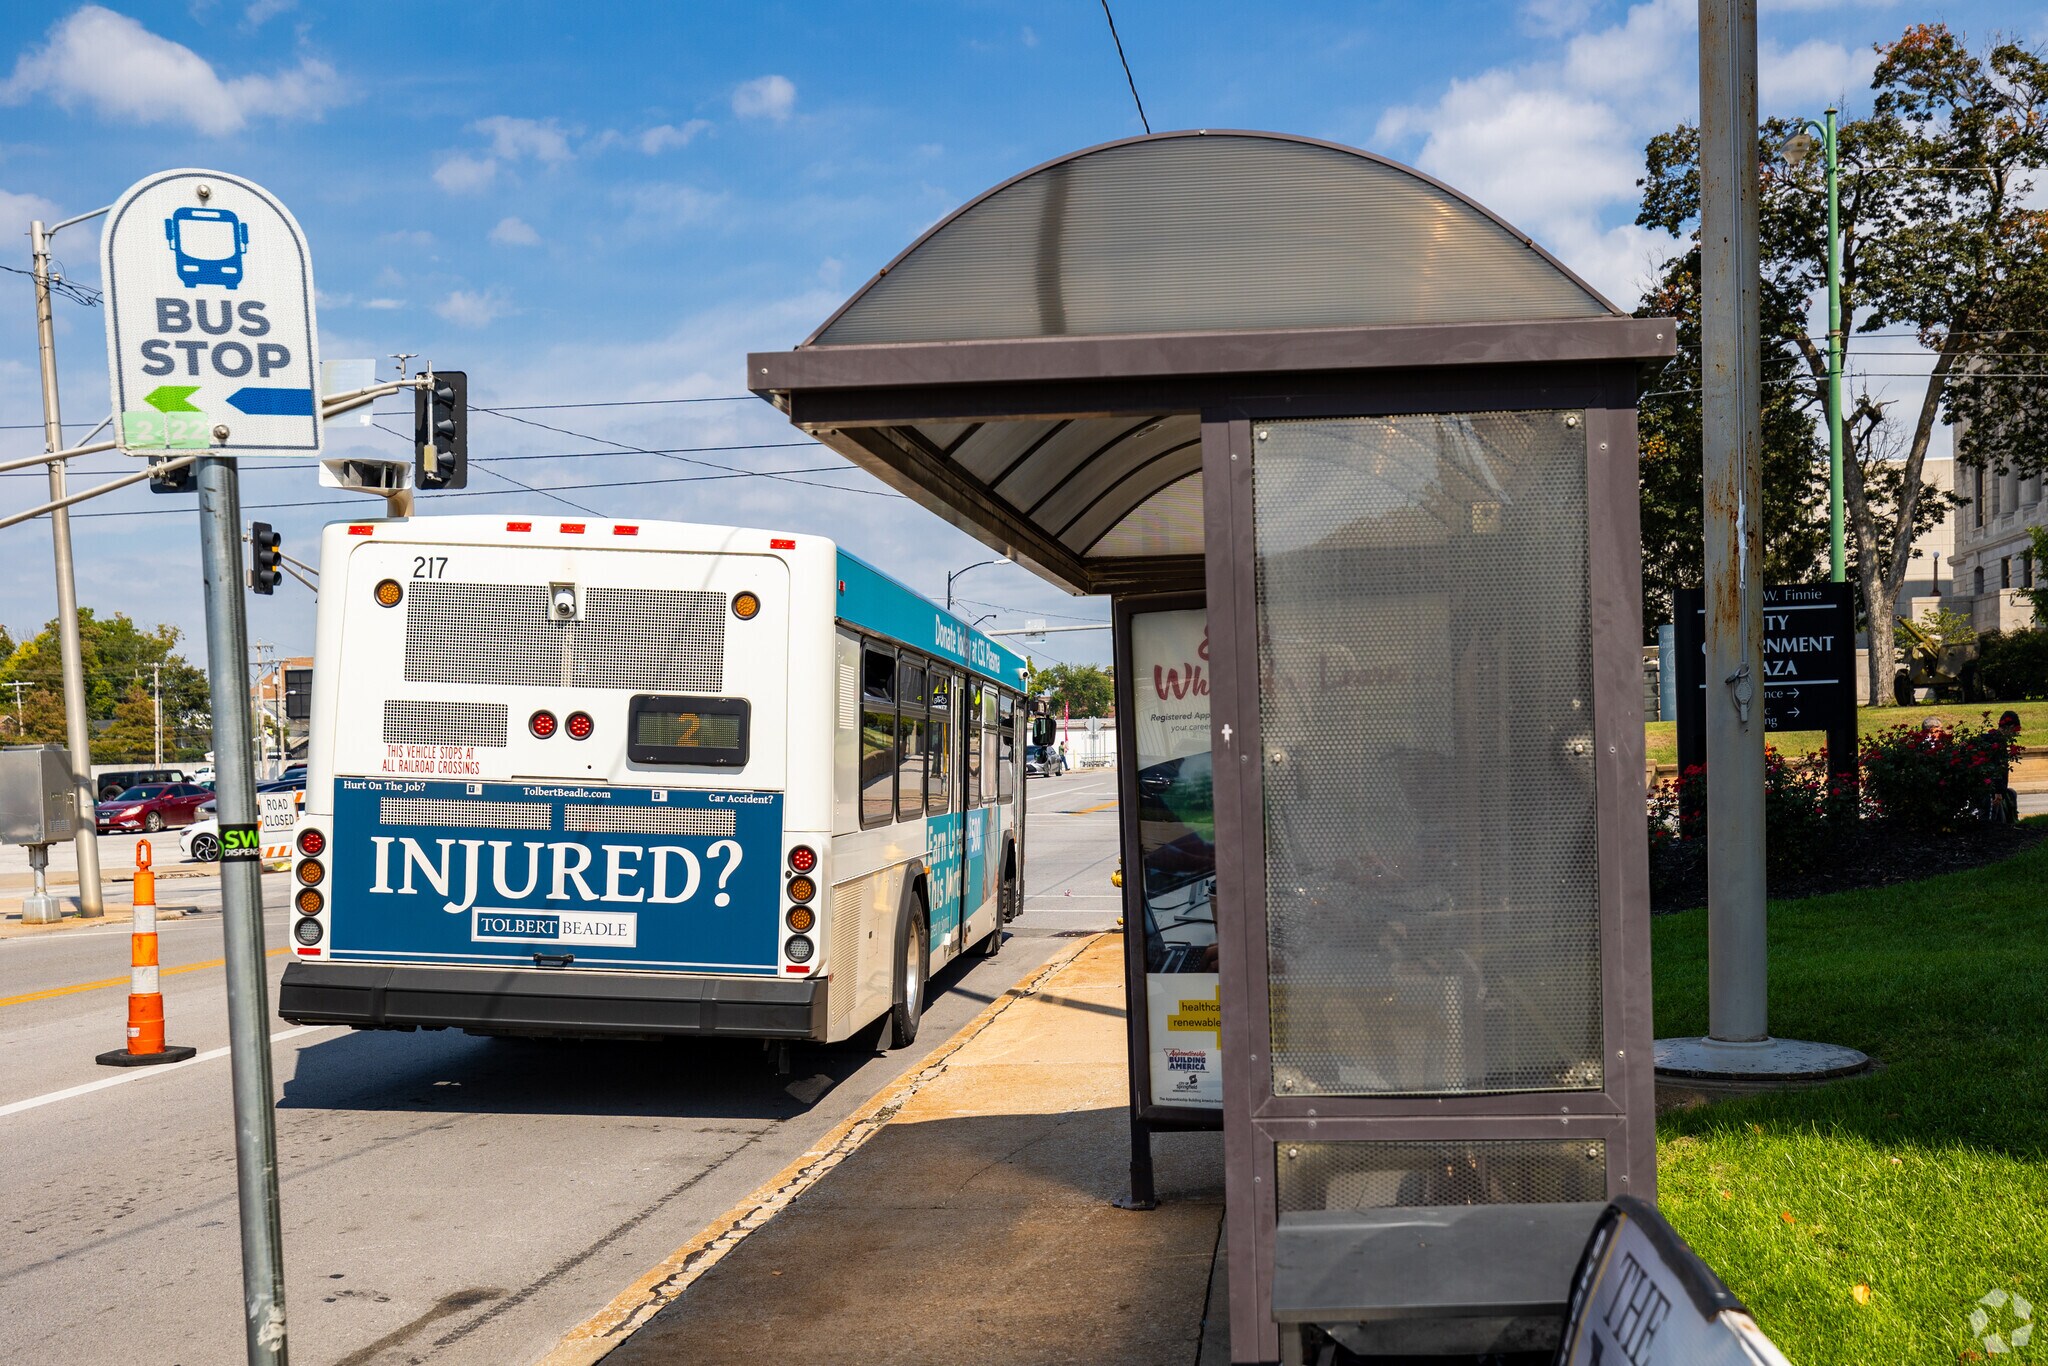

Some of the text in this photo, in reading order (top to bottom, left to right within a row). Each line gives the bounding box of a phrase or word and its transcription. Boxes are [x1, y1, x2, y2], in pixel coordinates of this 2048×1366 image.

[155, 297, 271, 337] BUS
[140, 338, 291, 379] STOP
[136, 419, 207, 440] 2 22
[412, 556, 449, 579] 217
[1785, 588, 1822, 601] Finnie
[935, 614, 956, 654] Donate
[1151, 712, 1193, 723] Registered
[677, 712, 700, 747] 2
[1171, 726, 1188, 734] your
[387, 744, 475, 760] THIS VEHICLE STOPS AT
[382, 759, 480, 775] ALL RAILROAD CROSSINGS
[343, 780, 426, 793] Hurt On The Job?
[523, 786, 611, 799] TolbertBeadle.com
[266, 798, 288, 811] ROAD
[708, 794, 774, 804] Car Accident?
[264, 814, 295, 827] CLOSED
[928, 825, 947, 865] Earn
[369, 835, 744, 914] INJURED?
[480, 917, 628, 937] TOLBERT BEADLE
[1173, 1018, 1221, 1027] renewable
[1169, 1056, 1206, 1064] BUILDING
[1169, 1063, 1206, 1071] AMERICA
[1603, 1251, 1672, 1366] THE
